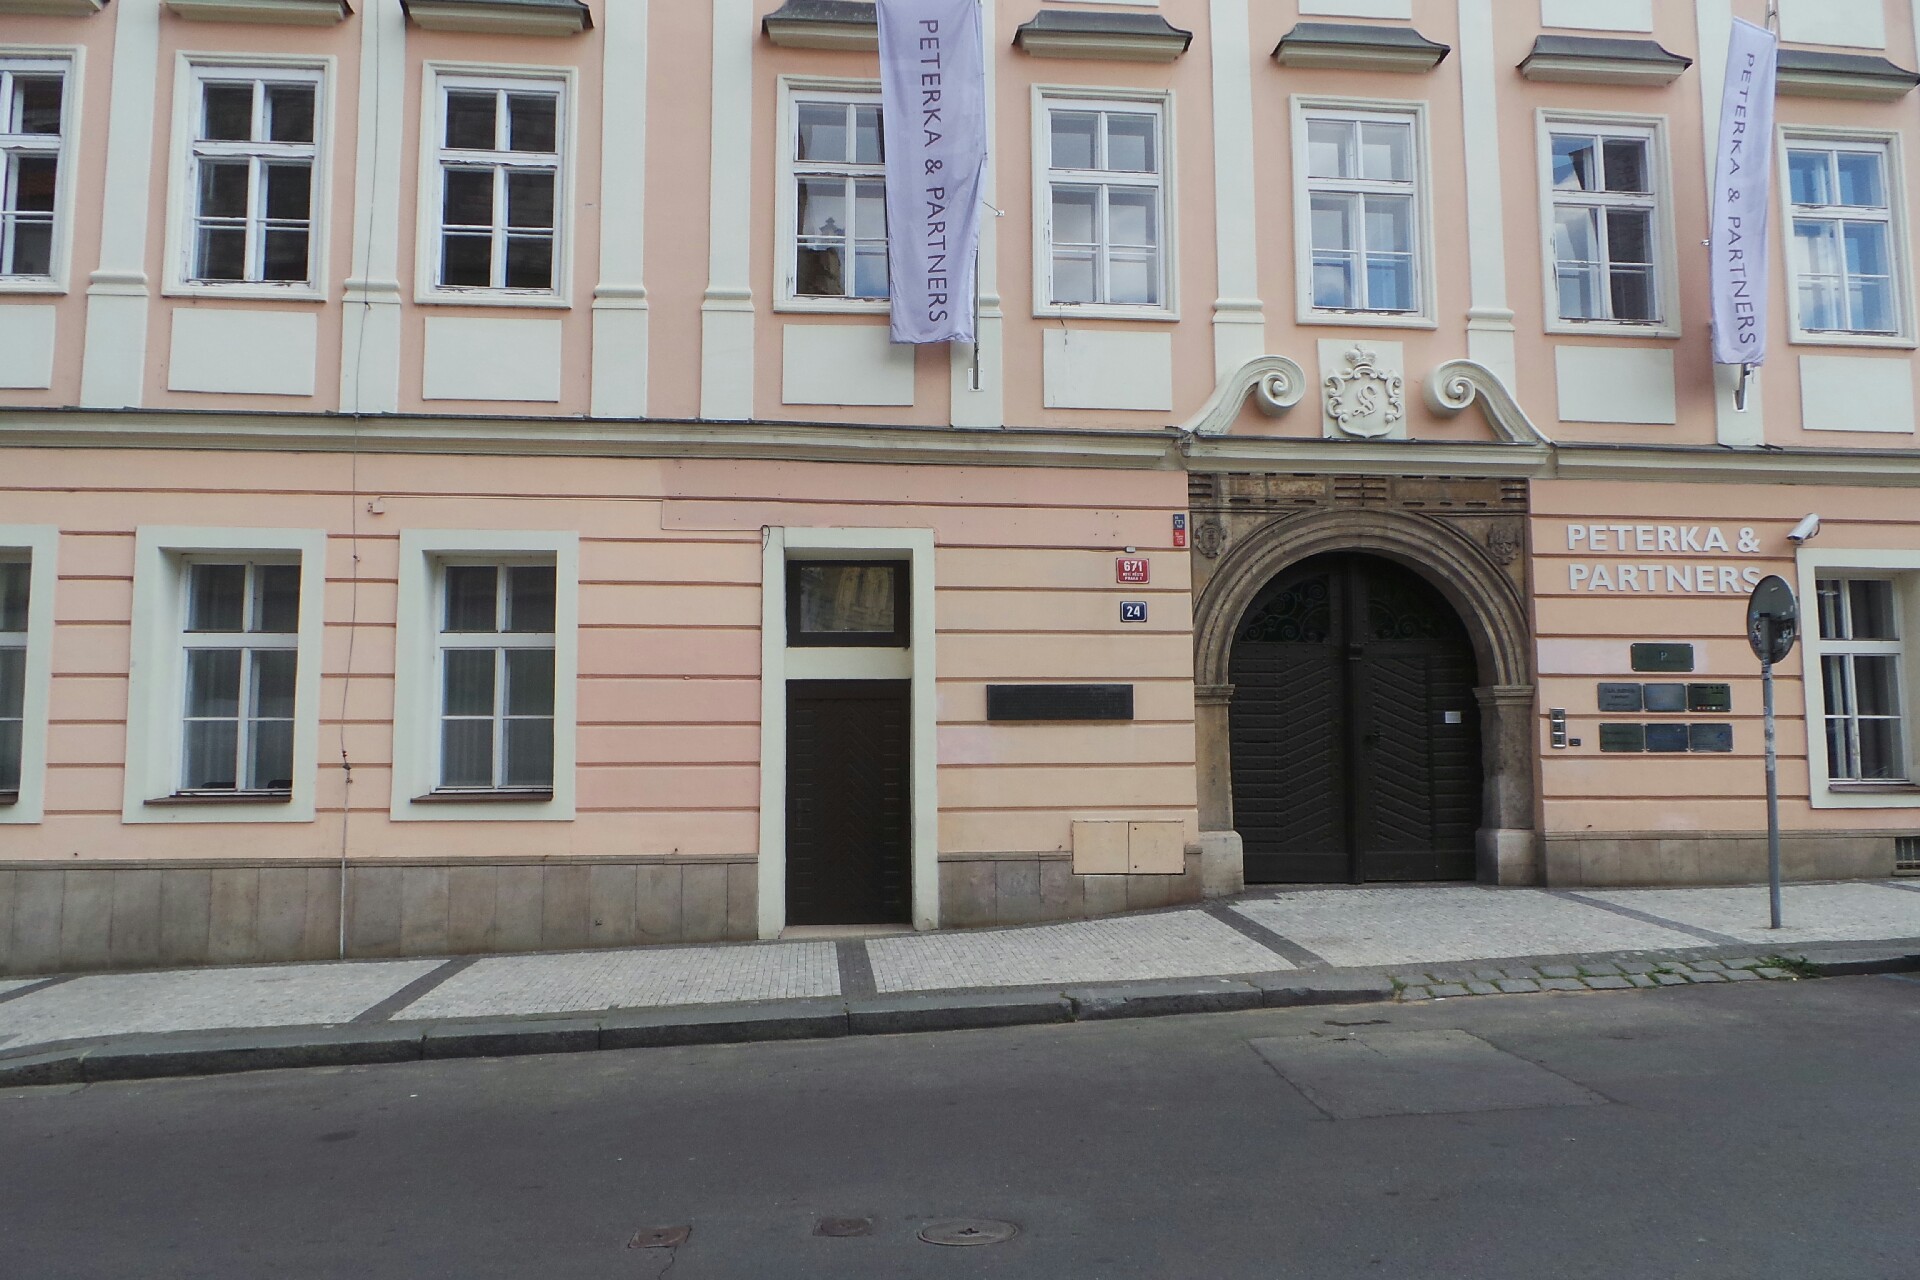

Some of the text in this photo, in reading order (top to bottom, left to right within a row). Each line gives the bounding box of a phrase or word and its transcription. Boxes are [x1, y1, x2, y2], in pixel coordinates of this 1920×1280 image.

[918, 19, 948, 323] PETERKA & PARTNERS
[1727, 52, 1756, 345] PETERKA & PARTNERS
[1567, 524, 1760, 553] PETERKA &
[1124, 560, 1142, 571] 671
[1569, 564, 1760, 593] PARTNERS
[1126, 606, 1140, 617] 24
